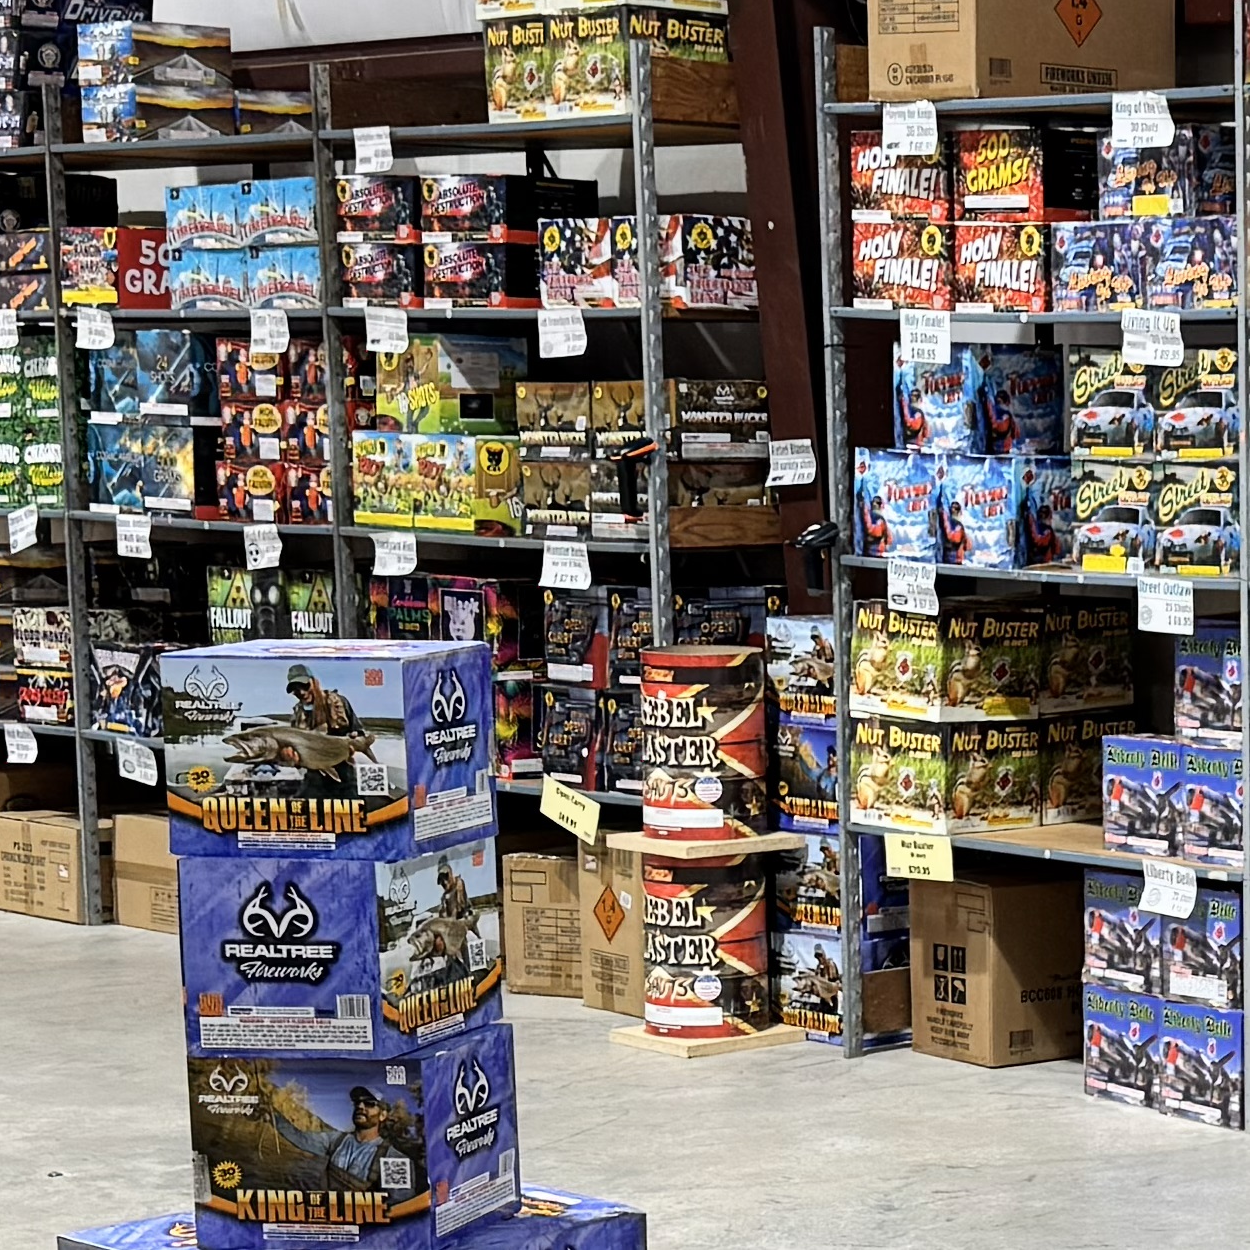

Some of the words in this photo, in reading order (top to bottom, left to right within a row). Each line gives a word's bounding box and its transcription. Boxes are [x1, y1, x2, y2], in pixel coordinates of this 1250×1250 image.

[487, 23, 508, 46] NUT
[550, 17, 573, 39] NUT
[577, 14, 620, 38] BUSTER
[629, 15, 661, 37] NUT
[666, 18, 725, 45] BUSTER
[1075, 14, 1083, 26] G
[976, 132, 1010, 164] 500
[872, 168, 937, 201] FINALE!
[966, 157, 1030, 193] GRAMS!
[859, 228, 903, 261] HOLY
[960, 231, 1002, 264] HOLY
[872, 258, 939, 292] FINALE!
[974, 260, 1038, 294] FINALE!
[1124, 314, 1150, 333] Living
[1163, 316, 1176, 334] Up
[1074, 356, 1123, 404] Street
[1077, 468, 1129, 520] Street
[1160, 469, 1210, 523] Street
[1139, 579, 1161, 594] Street
[210, 607, 252, 629] FALLOUT
[291, 611, 335, 634] FALLOUT
[388, 607, 431, 623] PALMS
[700, 621, 733, 633] OPEN
[857, 608, 885, 630] NUT
[888, 611, 938, 638] BUSTER
[948, 617, 979, 639] NUT
[982, 617, 1039, 639] BUSTER
[1077, 609, 1130, 630] BUSTER
[424, 724, 478, 747] REALTREE
[856, 723, 885, 746] NUT
[888, 725, 942, 752] BUSTER
[952, 732, 982, 752] NUT
[985, 730, 1039, 750] BUSTER
[1048, 722, 1078, 743] NUT
[643, 733, 720, 768] ASTER
[202, 796, 288, 834] QUEEN
[308, 797, 368, 834] LINE
[643, 896, 704, 929] EBEL
[224, 944, 334, 959] REALTREE
[239, 960, 324, 981] Fireworks
[398, 990, 440, 1034] QUEEN
[446, 1108, 498, 1142] REALTREE
[236, 1188, 306, 1223] KING
[329, 1190, 392, 1224] LINE
